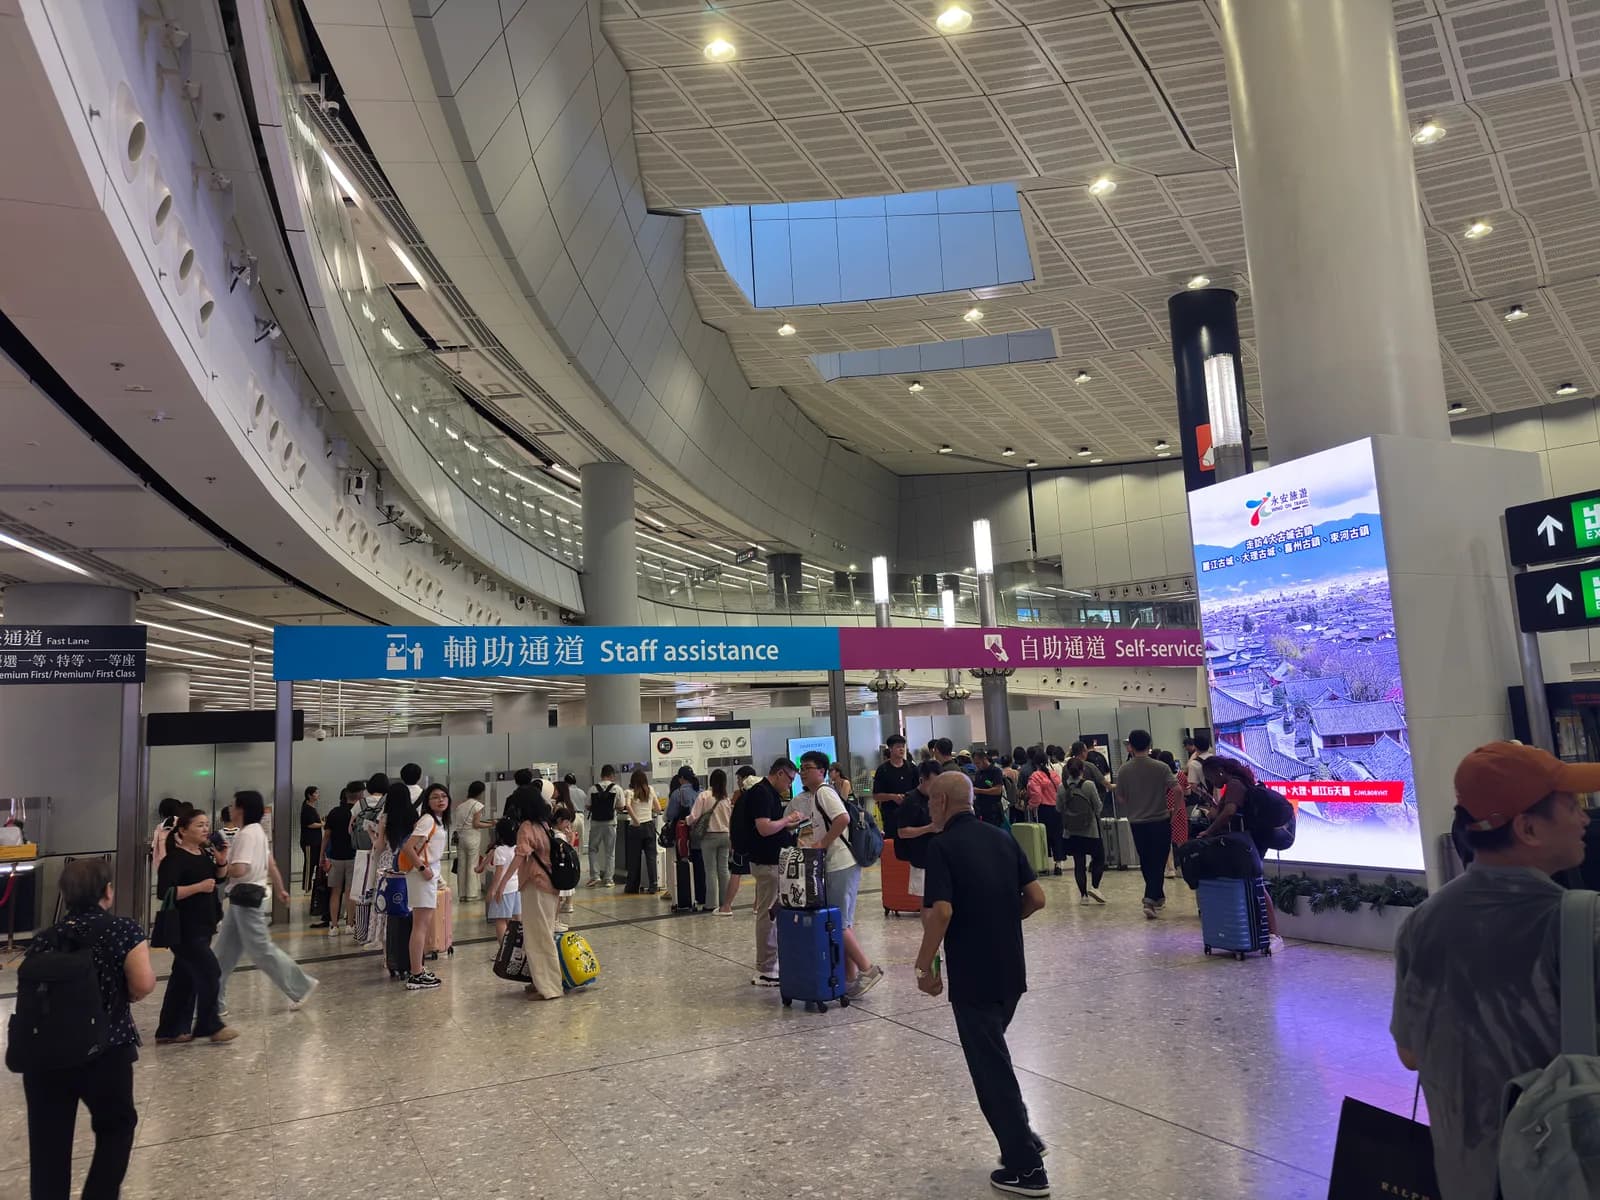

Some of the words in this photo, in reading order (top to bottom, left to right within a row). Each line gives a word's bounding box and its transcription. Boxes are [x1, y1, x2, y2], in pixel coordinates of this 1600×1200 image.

[1271, 488, 1308, 506] 永安旅遊
[0, 630, 42, 647] 通道
[47, 637, 65, 645] Fast
[68, 637, 90, 645] Lane
[442, 635, 586, 668] 輔助通道
[600, 639, 658, 662] Staff
[663, 640, 780, 662] assistance
[1020, 635, 1107, 661] 自助通道
[1115, 639, 1204, 659] Self-service
[0, 653, 136, 668] 選一等、特等、一等座
[30, 670, 53, 679] First/
[54, 669, 95, 679] Premium/
[97, 669, 114, 678] First
[115, 669, 136, 678] Class
